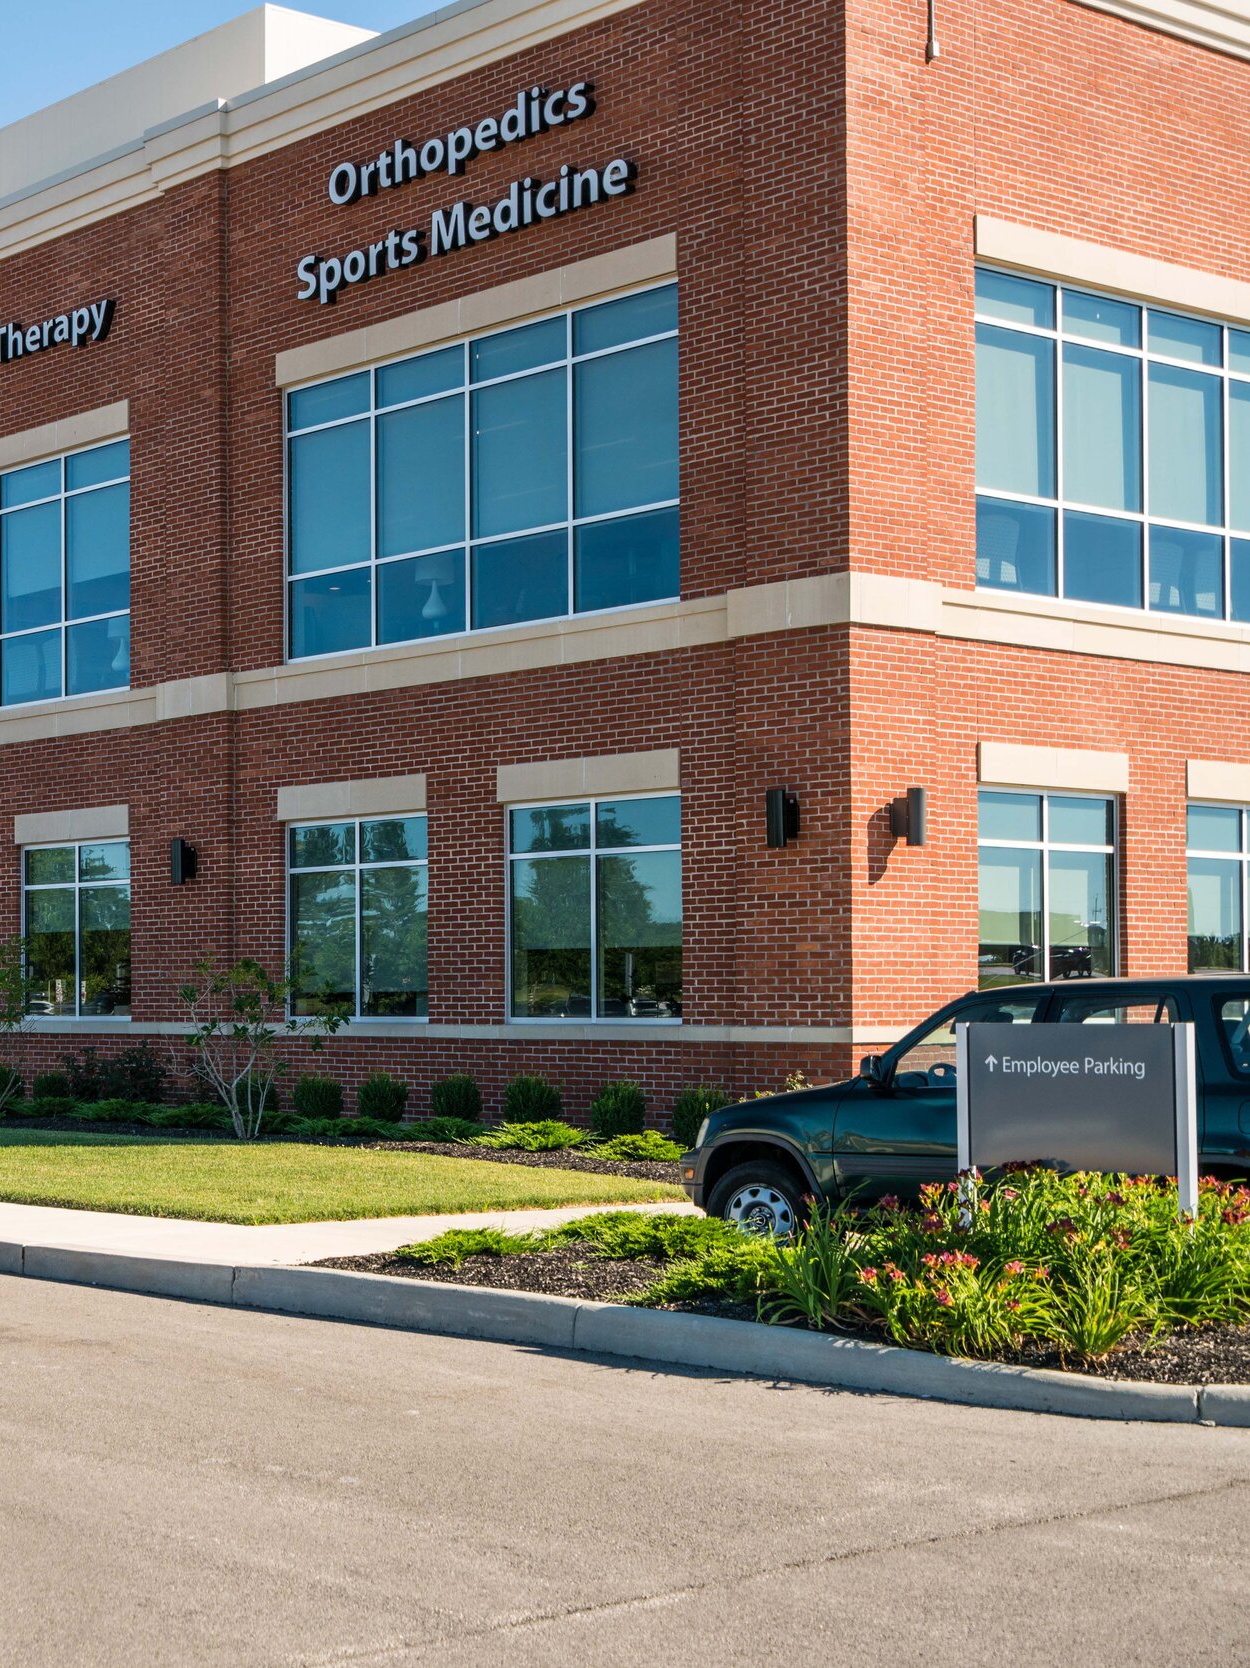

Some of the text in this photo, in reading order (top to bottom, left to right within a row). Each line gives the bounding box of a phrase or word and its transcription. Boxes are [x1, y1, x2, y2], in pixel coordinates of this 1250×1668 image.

[328, 82, 588, 205] Orthopedics
[297, 158, 630, 304] Sports Medicine
[1002, 1056, 1146, 1079] Employee Parking
